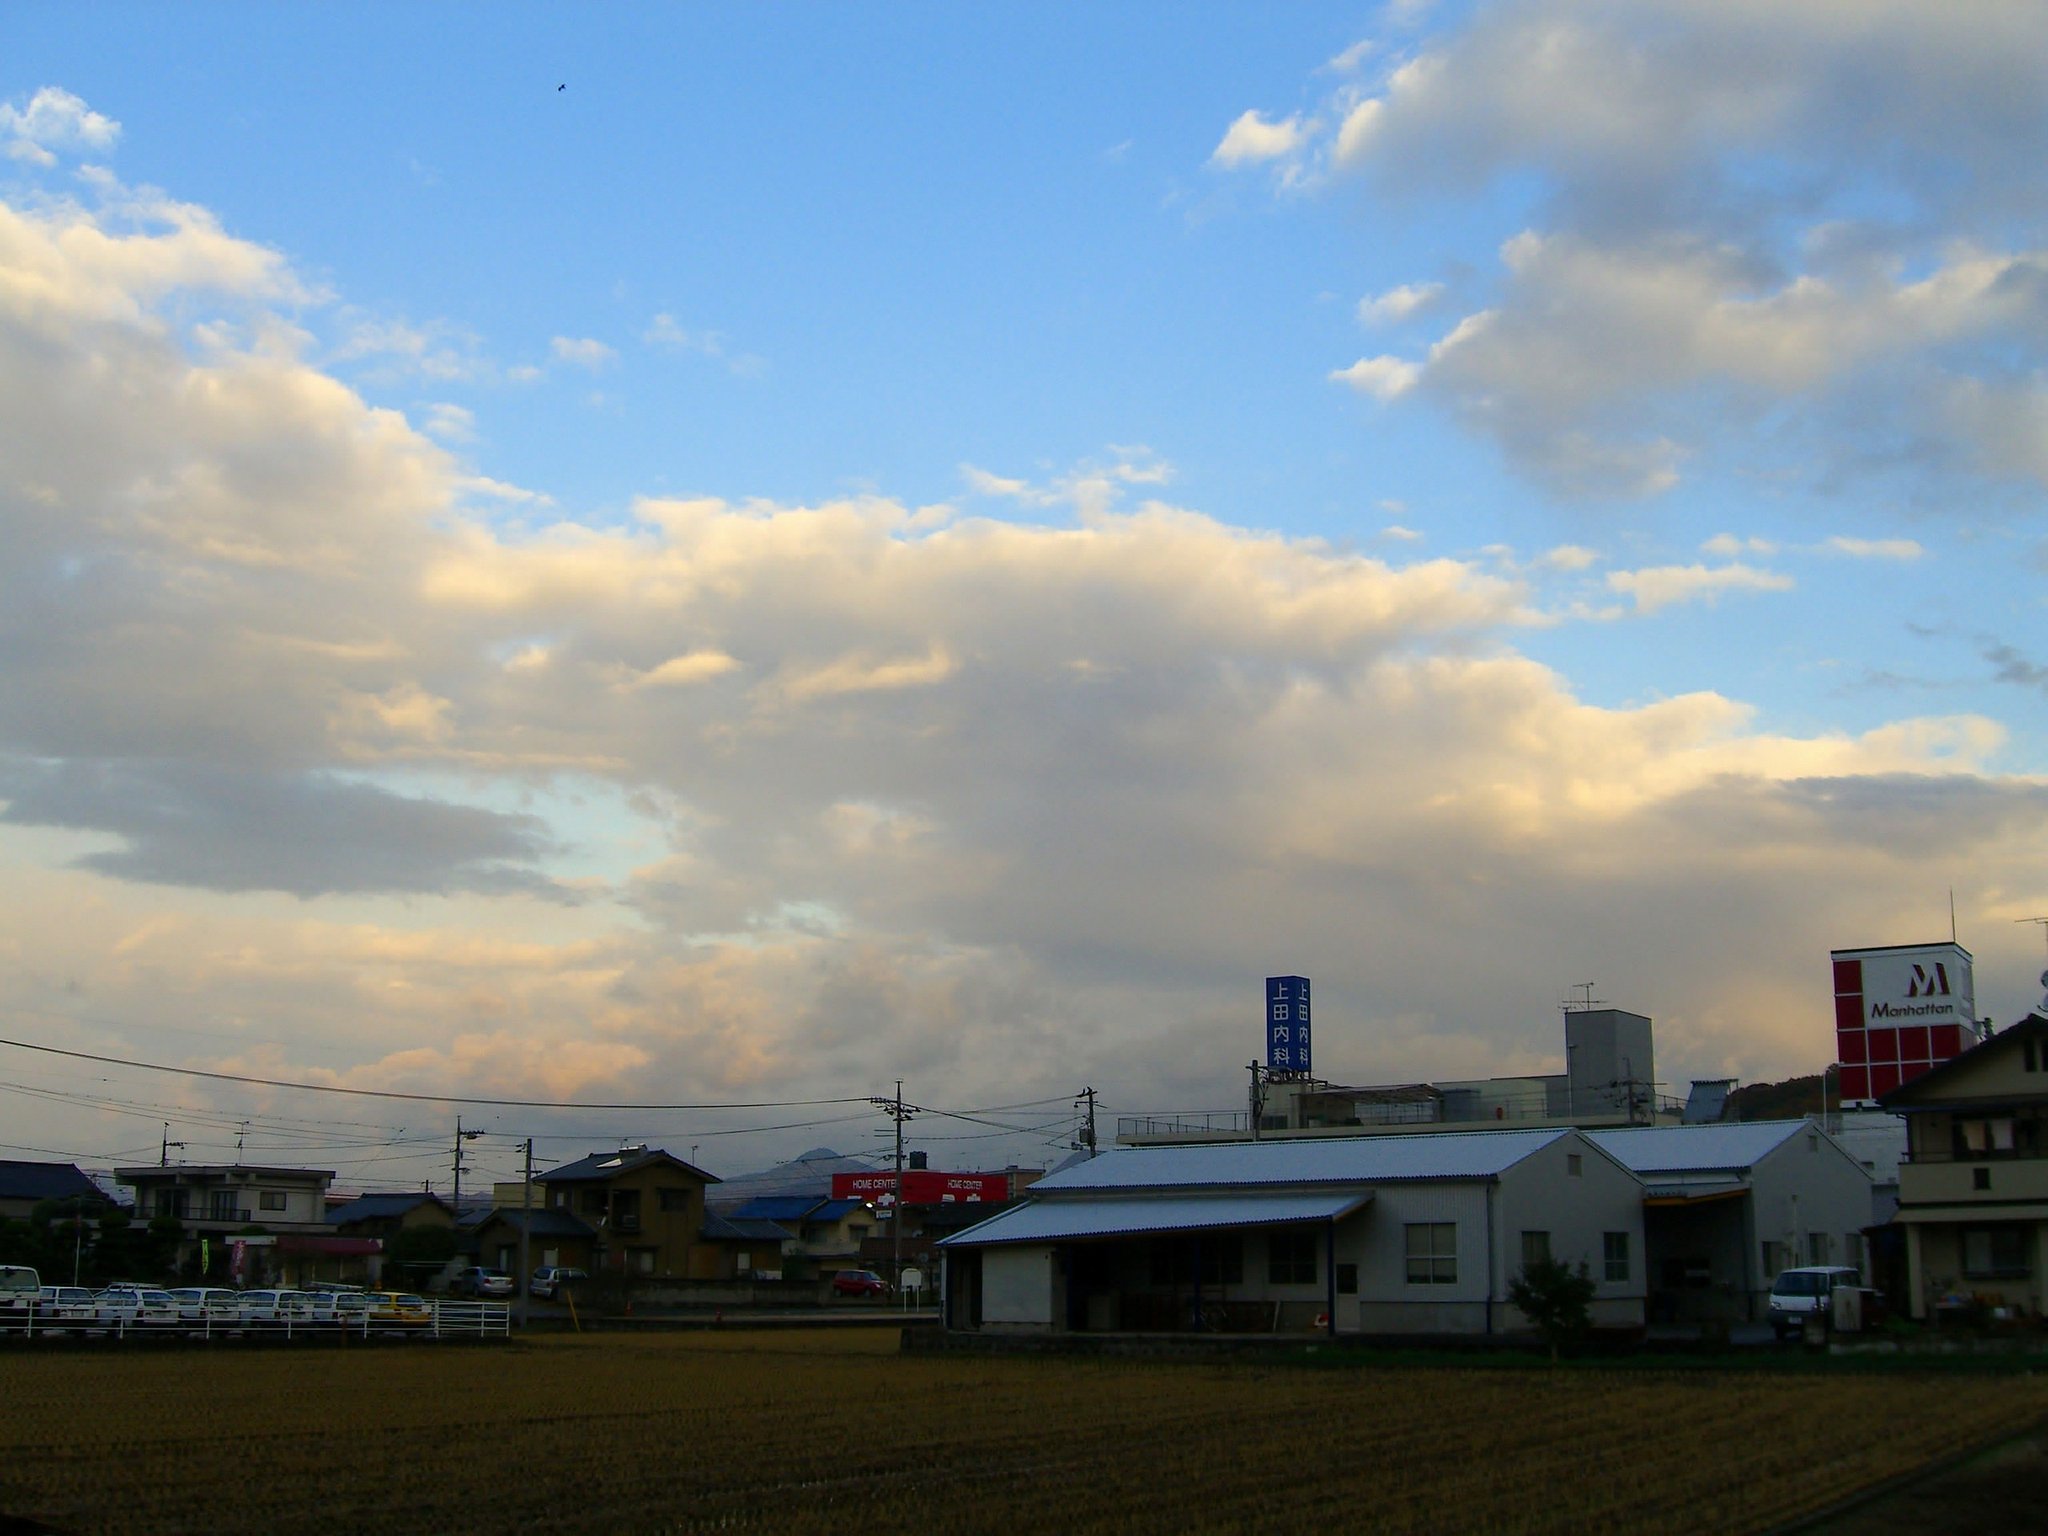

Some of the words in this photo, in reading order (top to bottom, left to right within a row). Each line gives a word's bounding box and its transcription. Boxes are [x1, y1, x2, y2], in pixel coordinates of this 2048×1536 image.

[1872, 1002, 1953, 1018] Manhattan
[1273, 982, 1290, 1065] 上田内科
[1298, 983, 1308, 1065] 上田内科
[853, 1179, 872, 1190] HOME
[873, 1179, 897, 1190] CENTE
[947, 1178, 962, 1189] HOME
[963, 1179, 983, 1190] CENTER
